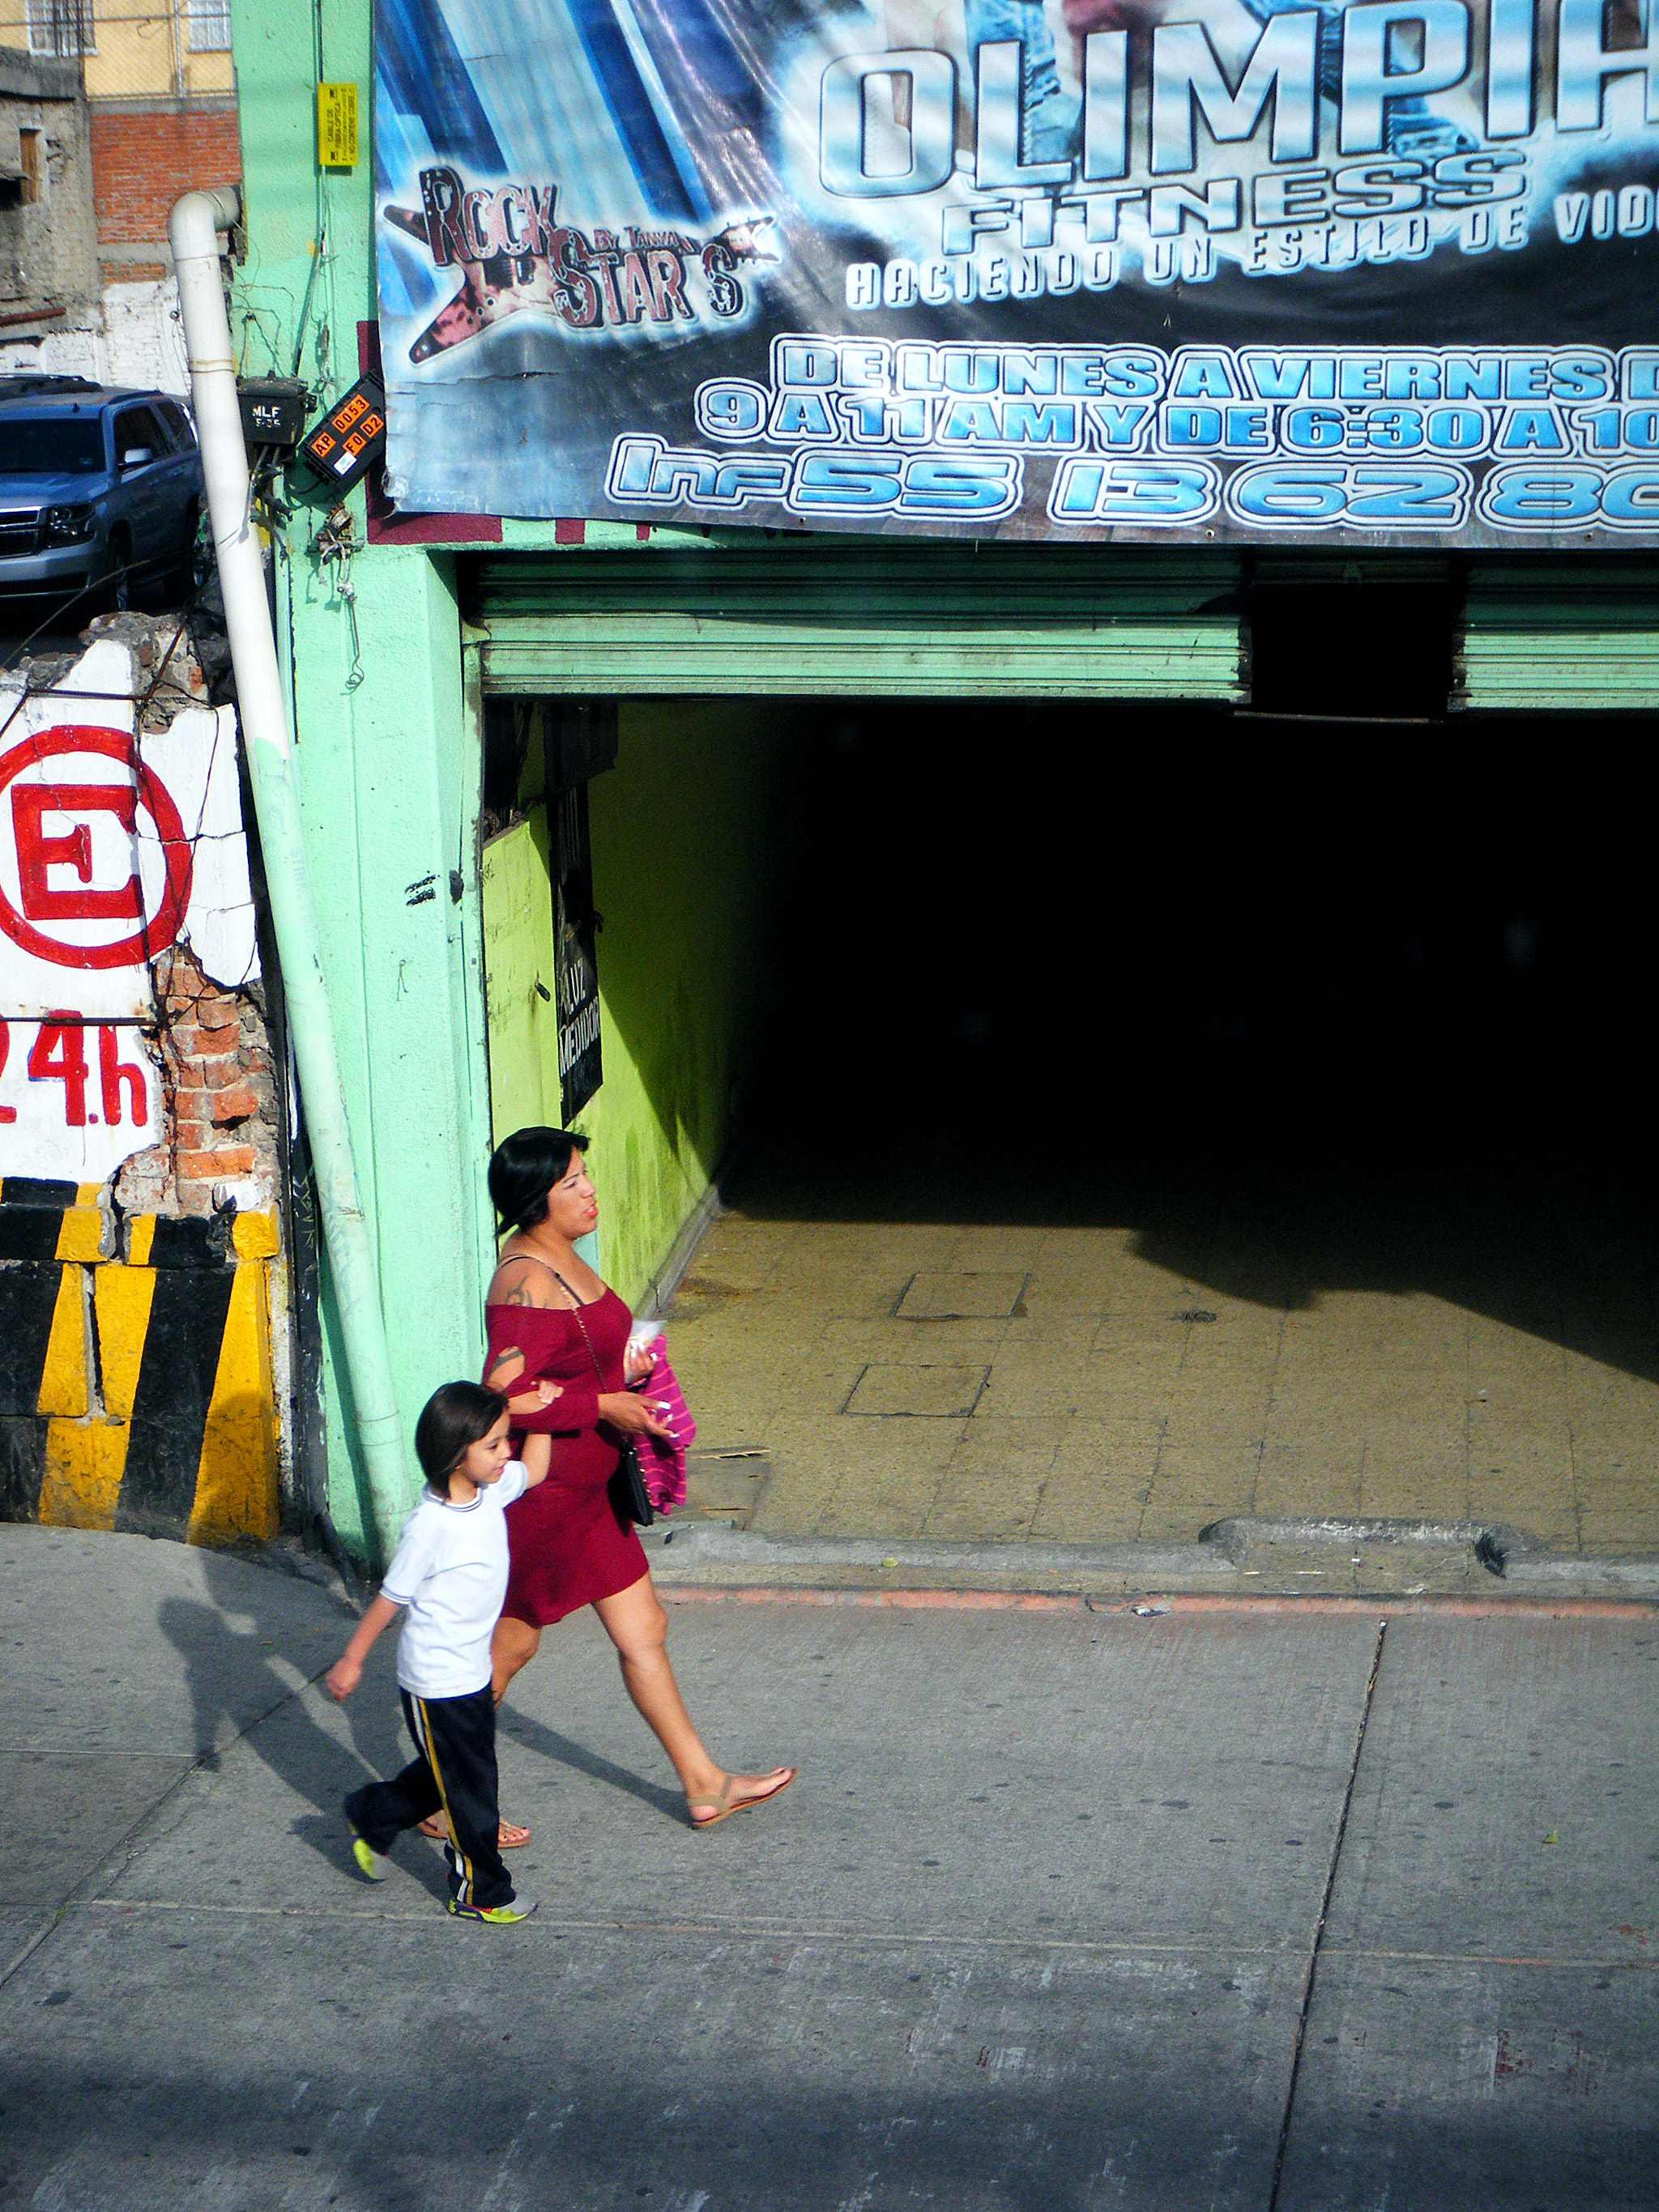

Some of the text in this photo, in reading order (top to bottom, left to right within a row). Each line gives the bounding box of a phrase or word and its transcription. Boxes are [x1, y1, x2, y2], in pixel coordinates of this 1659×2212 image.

[419, 165, 557, 267] ROCK
[942, 149, 1526, 256] FITNESS
[593, 225, 679, 249] BY TANYA
[848, 185, 1659, 308] HACIENDO UN ESTILO DE VID
[783, 344, 886, 390] DE
[902, 353, 1160, 398] LUNES
[1173, 357, 1235, 399] A
[1247, 357, 1609, 401] VIERNES
[314, 435, 333, 455] AP
[335, 399, 367, 430] 0053
[363, 417, 382, 435] D2
[708, 389, 761, 432] 9
[774, 392, 831, 435] A
[941, 401, 1077, 444] AM
[1091, 403, 1149, 445] Y
[1165, 405, 1271, 447] DE
[1288, 405, 1488, 450] 6:30
[1499, 406, 1565, 450] A
[796, 456, 1011, 510] 55
[1061, 465, 1209, 517] 13
[1237, 467, 1461, 520] 62
[11, 783, 144, 921] E
[0, 1008, 148, 1127] 4.h
